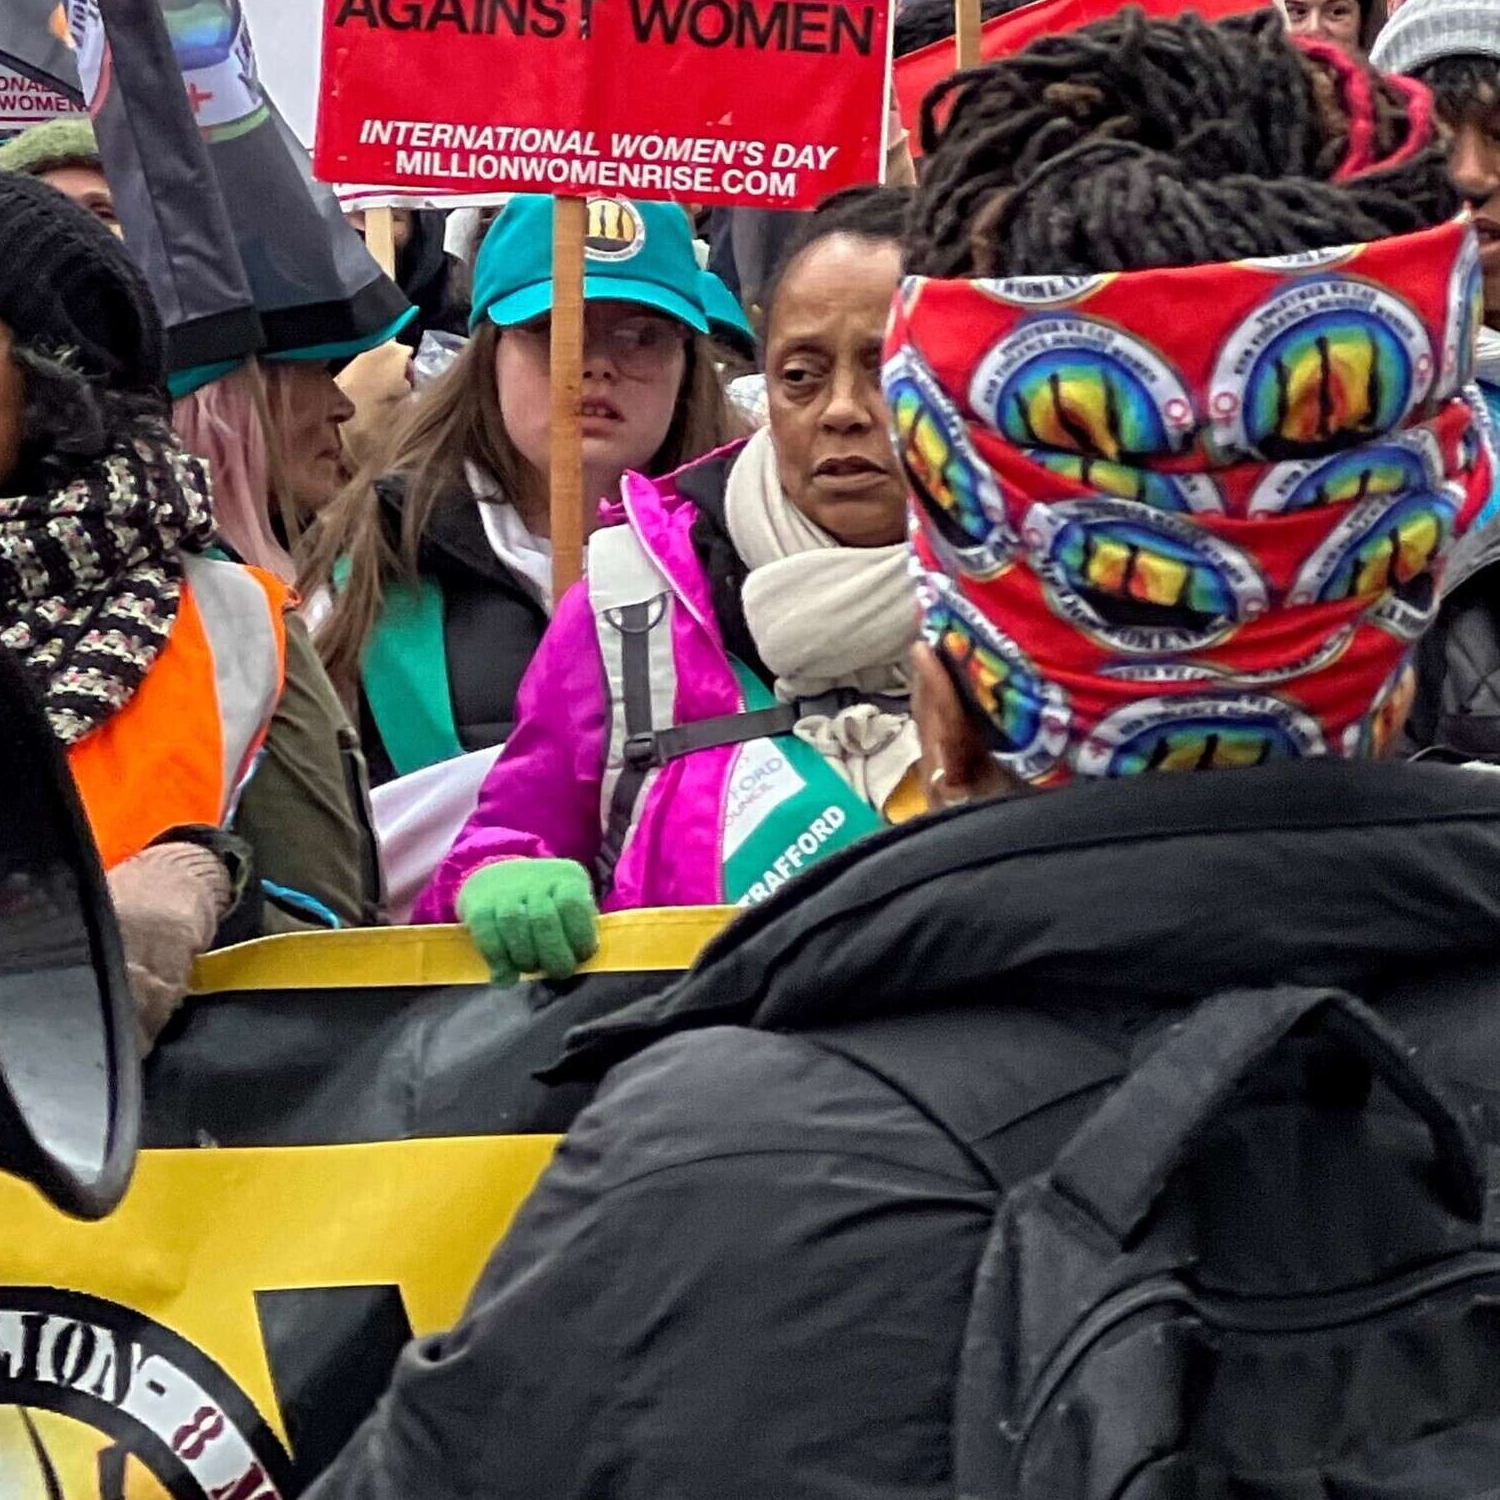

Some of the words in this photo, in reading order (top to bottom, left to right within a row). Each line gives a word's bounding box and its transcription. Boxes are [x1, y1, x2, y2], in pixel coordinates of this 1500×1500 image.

[359, 119, 600, 157] INTERNATIONAL
[610, 133, 766, 167] WOMEN'S
[771, 142, 838, 171] DAY
[395, 149, 797, 198] MILLIONWOMENRISE.COM
